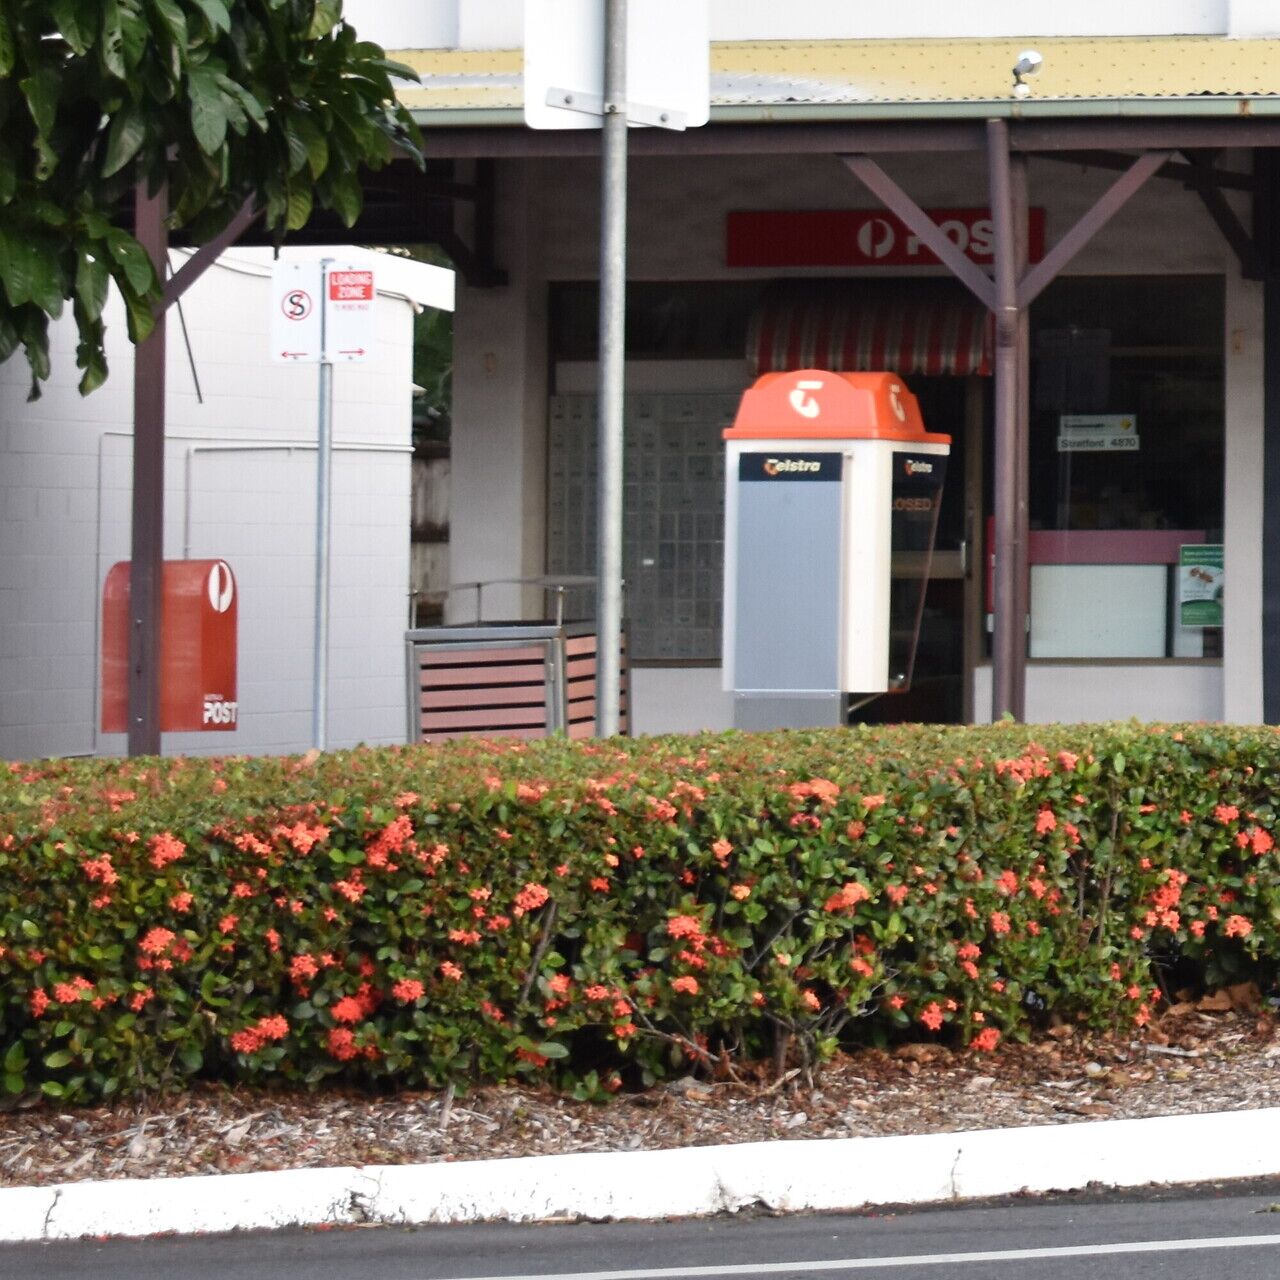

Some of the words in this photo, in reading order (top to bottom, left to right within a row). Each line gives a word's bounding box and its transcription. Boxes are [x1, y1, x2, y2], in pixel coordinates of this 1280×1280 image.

[338, 286, 365, 298] ZONE
[764, 458, 821, 475] Telstra
[893, 498, 932, 512] OSED
[203, 701, 238, 724] POST
